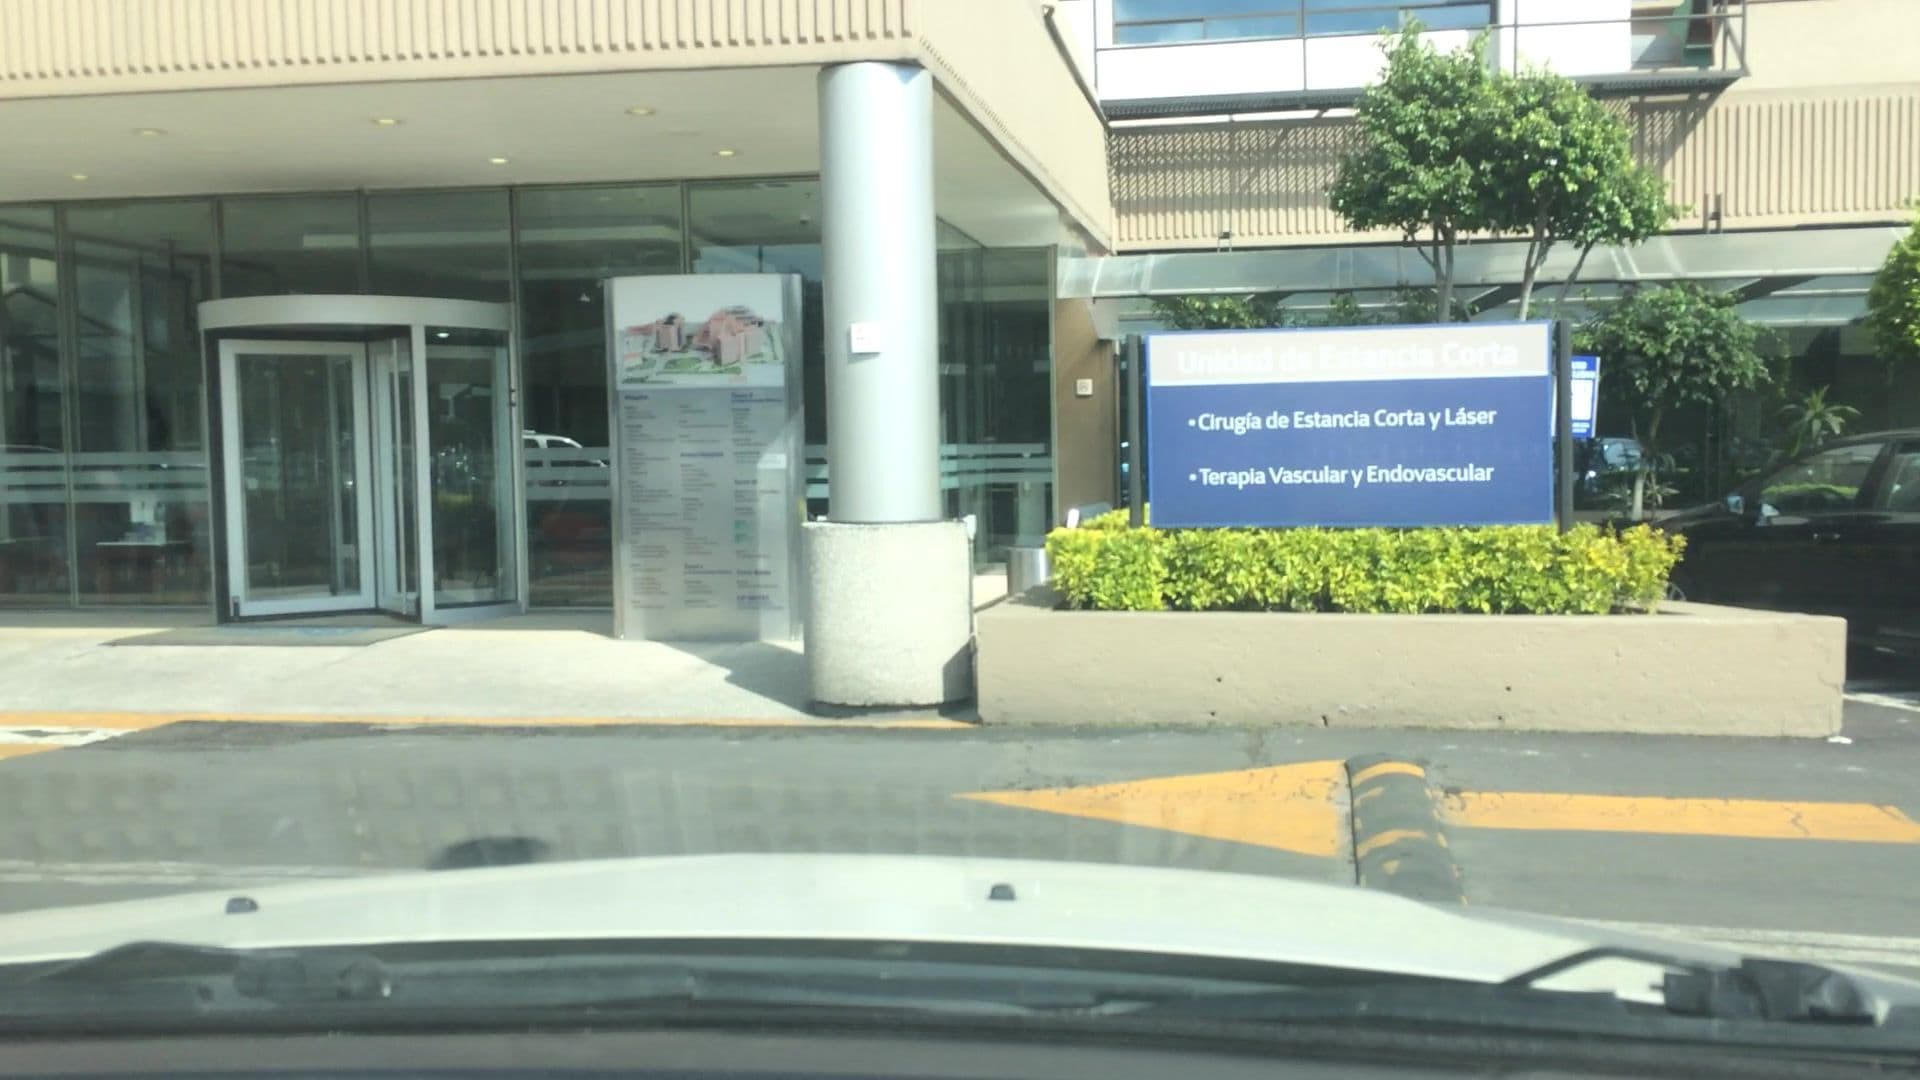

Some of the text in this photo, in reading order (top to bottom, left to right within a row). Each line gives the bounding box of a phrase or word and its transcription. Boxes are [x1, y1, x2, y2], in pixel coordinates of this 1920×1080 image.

[1177, 346, 1272, 374] Unidad
[1280, 346, 1312, 372] de
[1441, 341, 1518, 368] Corta
[1198, 407, 1497, 436] Cirugía de Estancia Corta y Láser
[1199, 463, 1495, 490] Terapia Vascular y Endovascular
